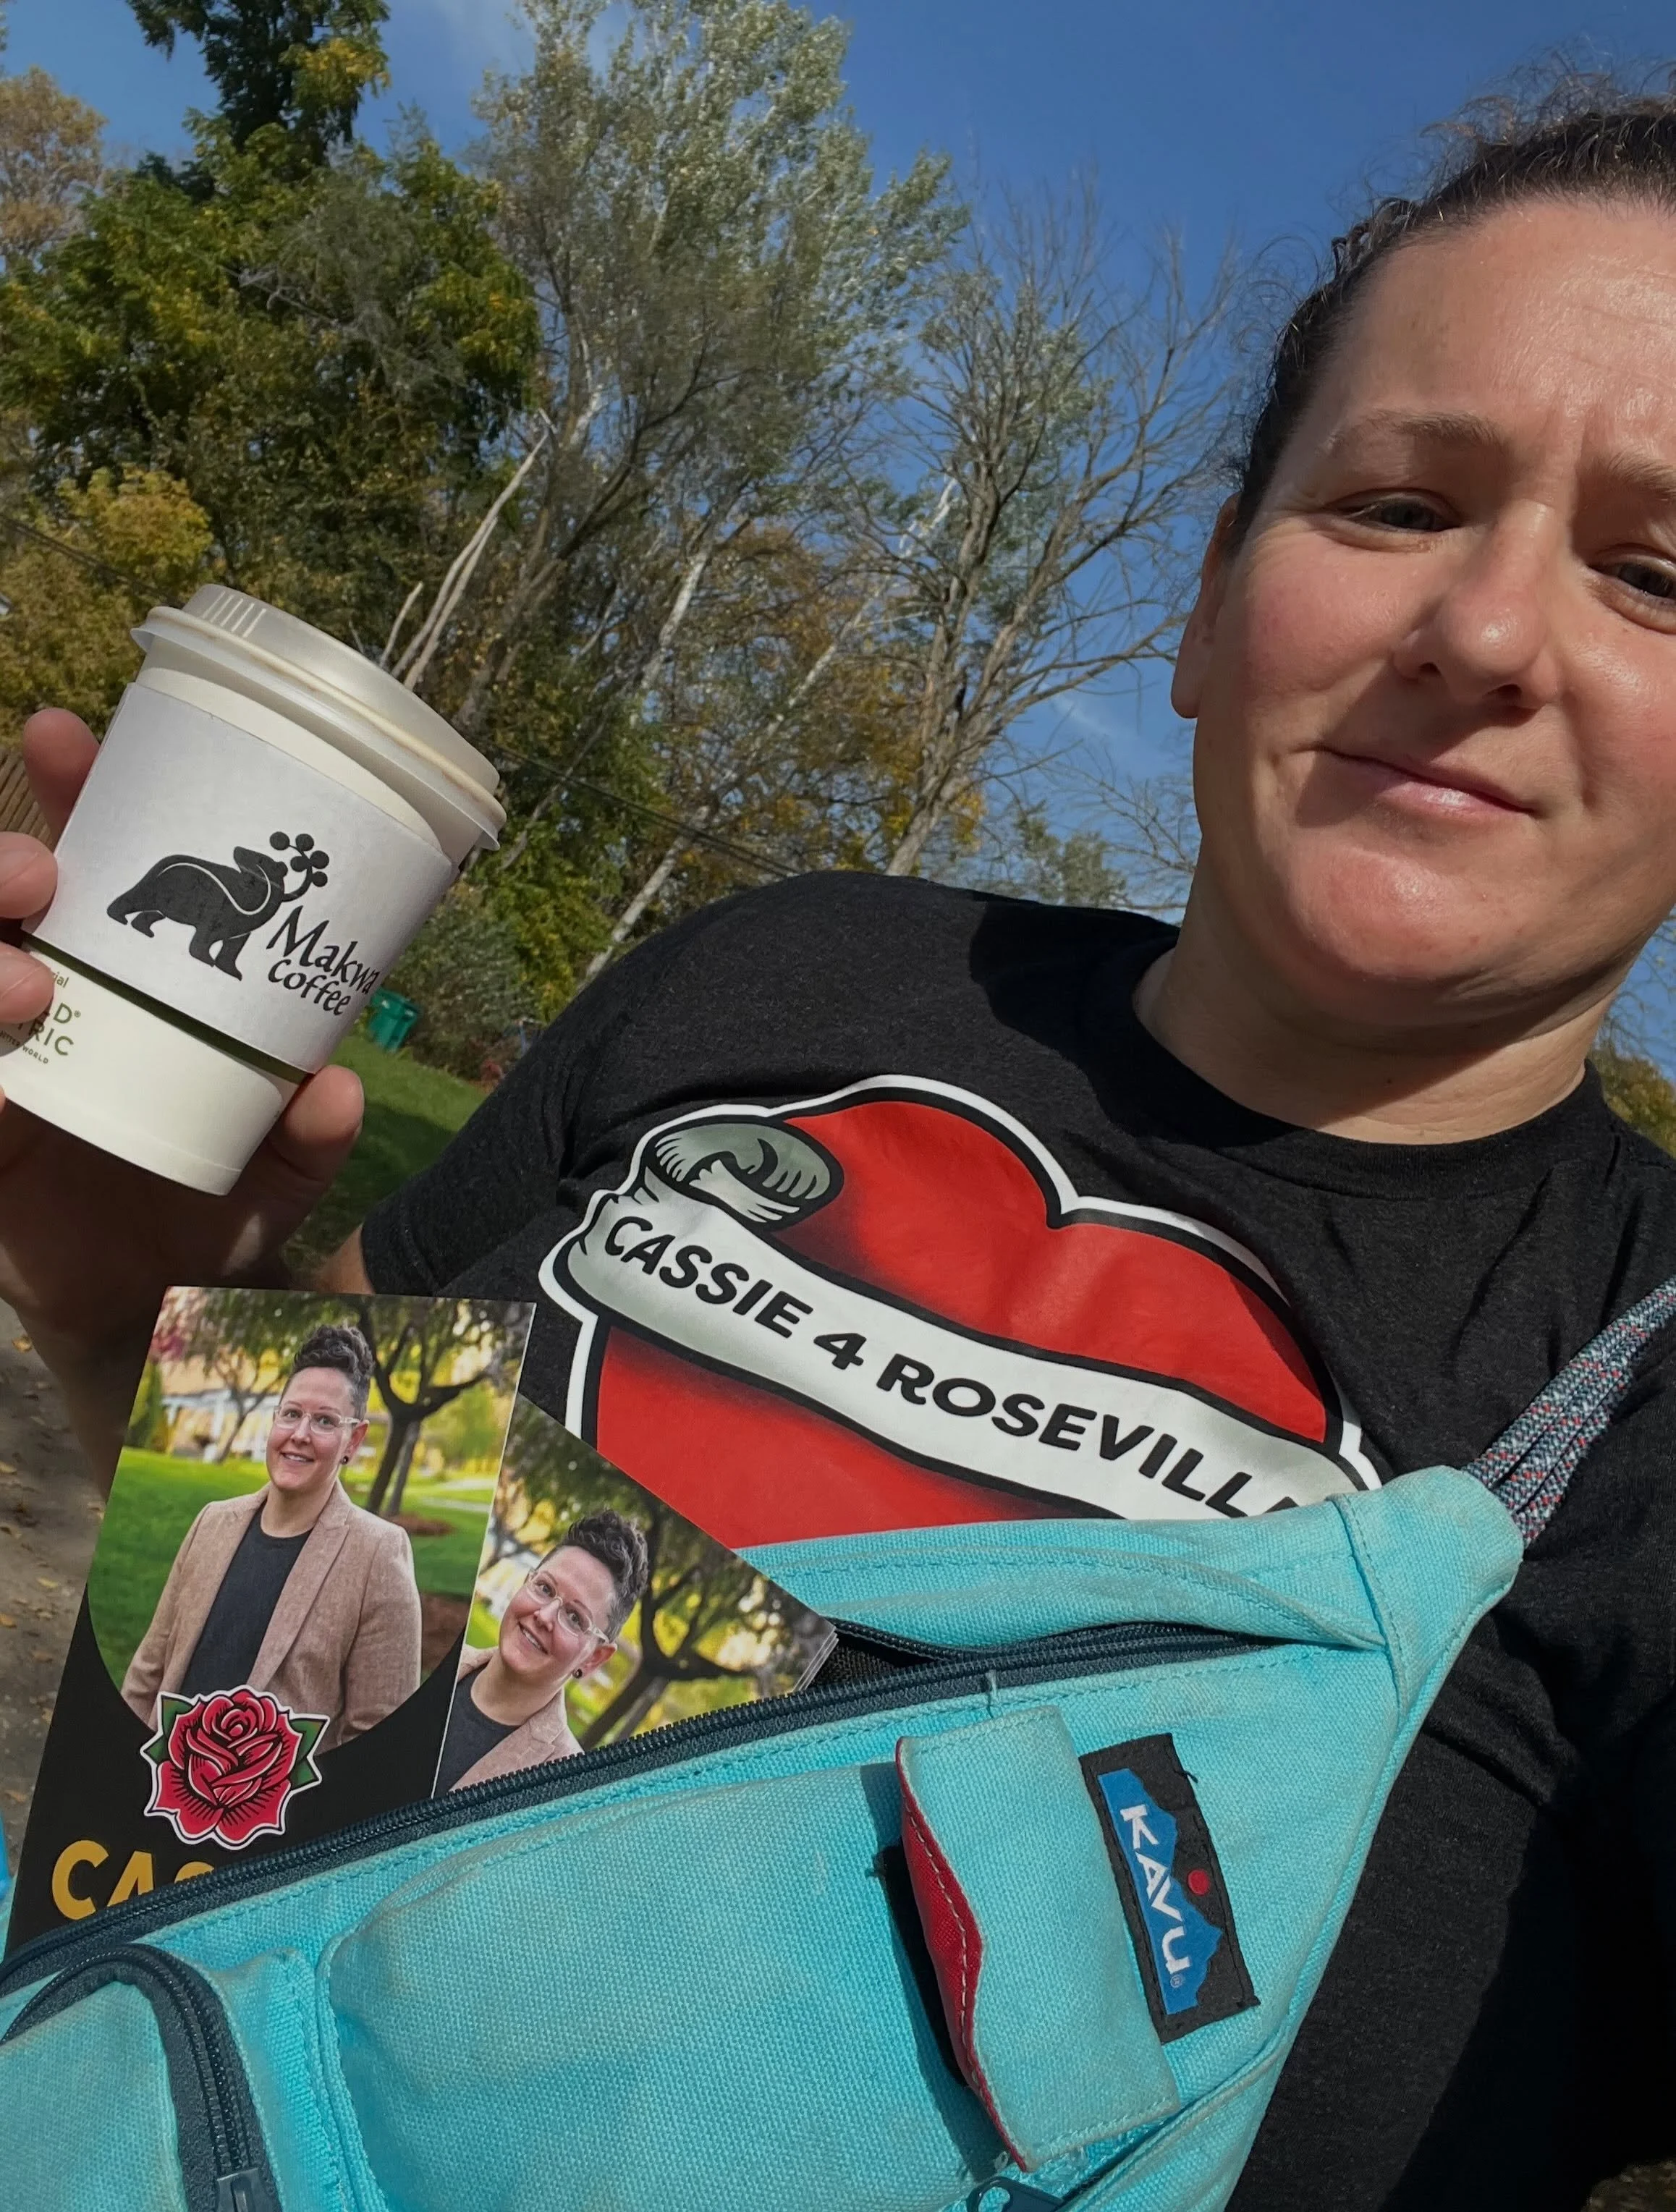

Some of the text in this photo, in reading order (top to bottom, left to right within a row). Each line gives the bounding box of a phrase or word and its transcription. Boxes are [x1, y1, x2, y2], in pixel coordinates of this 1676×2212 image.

[266, 905, 380, 994] Makwa
[268, 959, 351, 1016] Coffee
[22, 1045, 48, 1064] WORLD
[605, 1216, 1300, 1519] CASSIE 4 ROSEVILL
